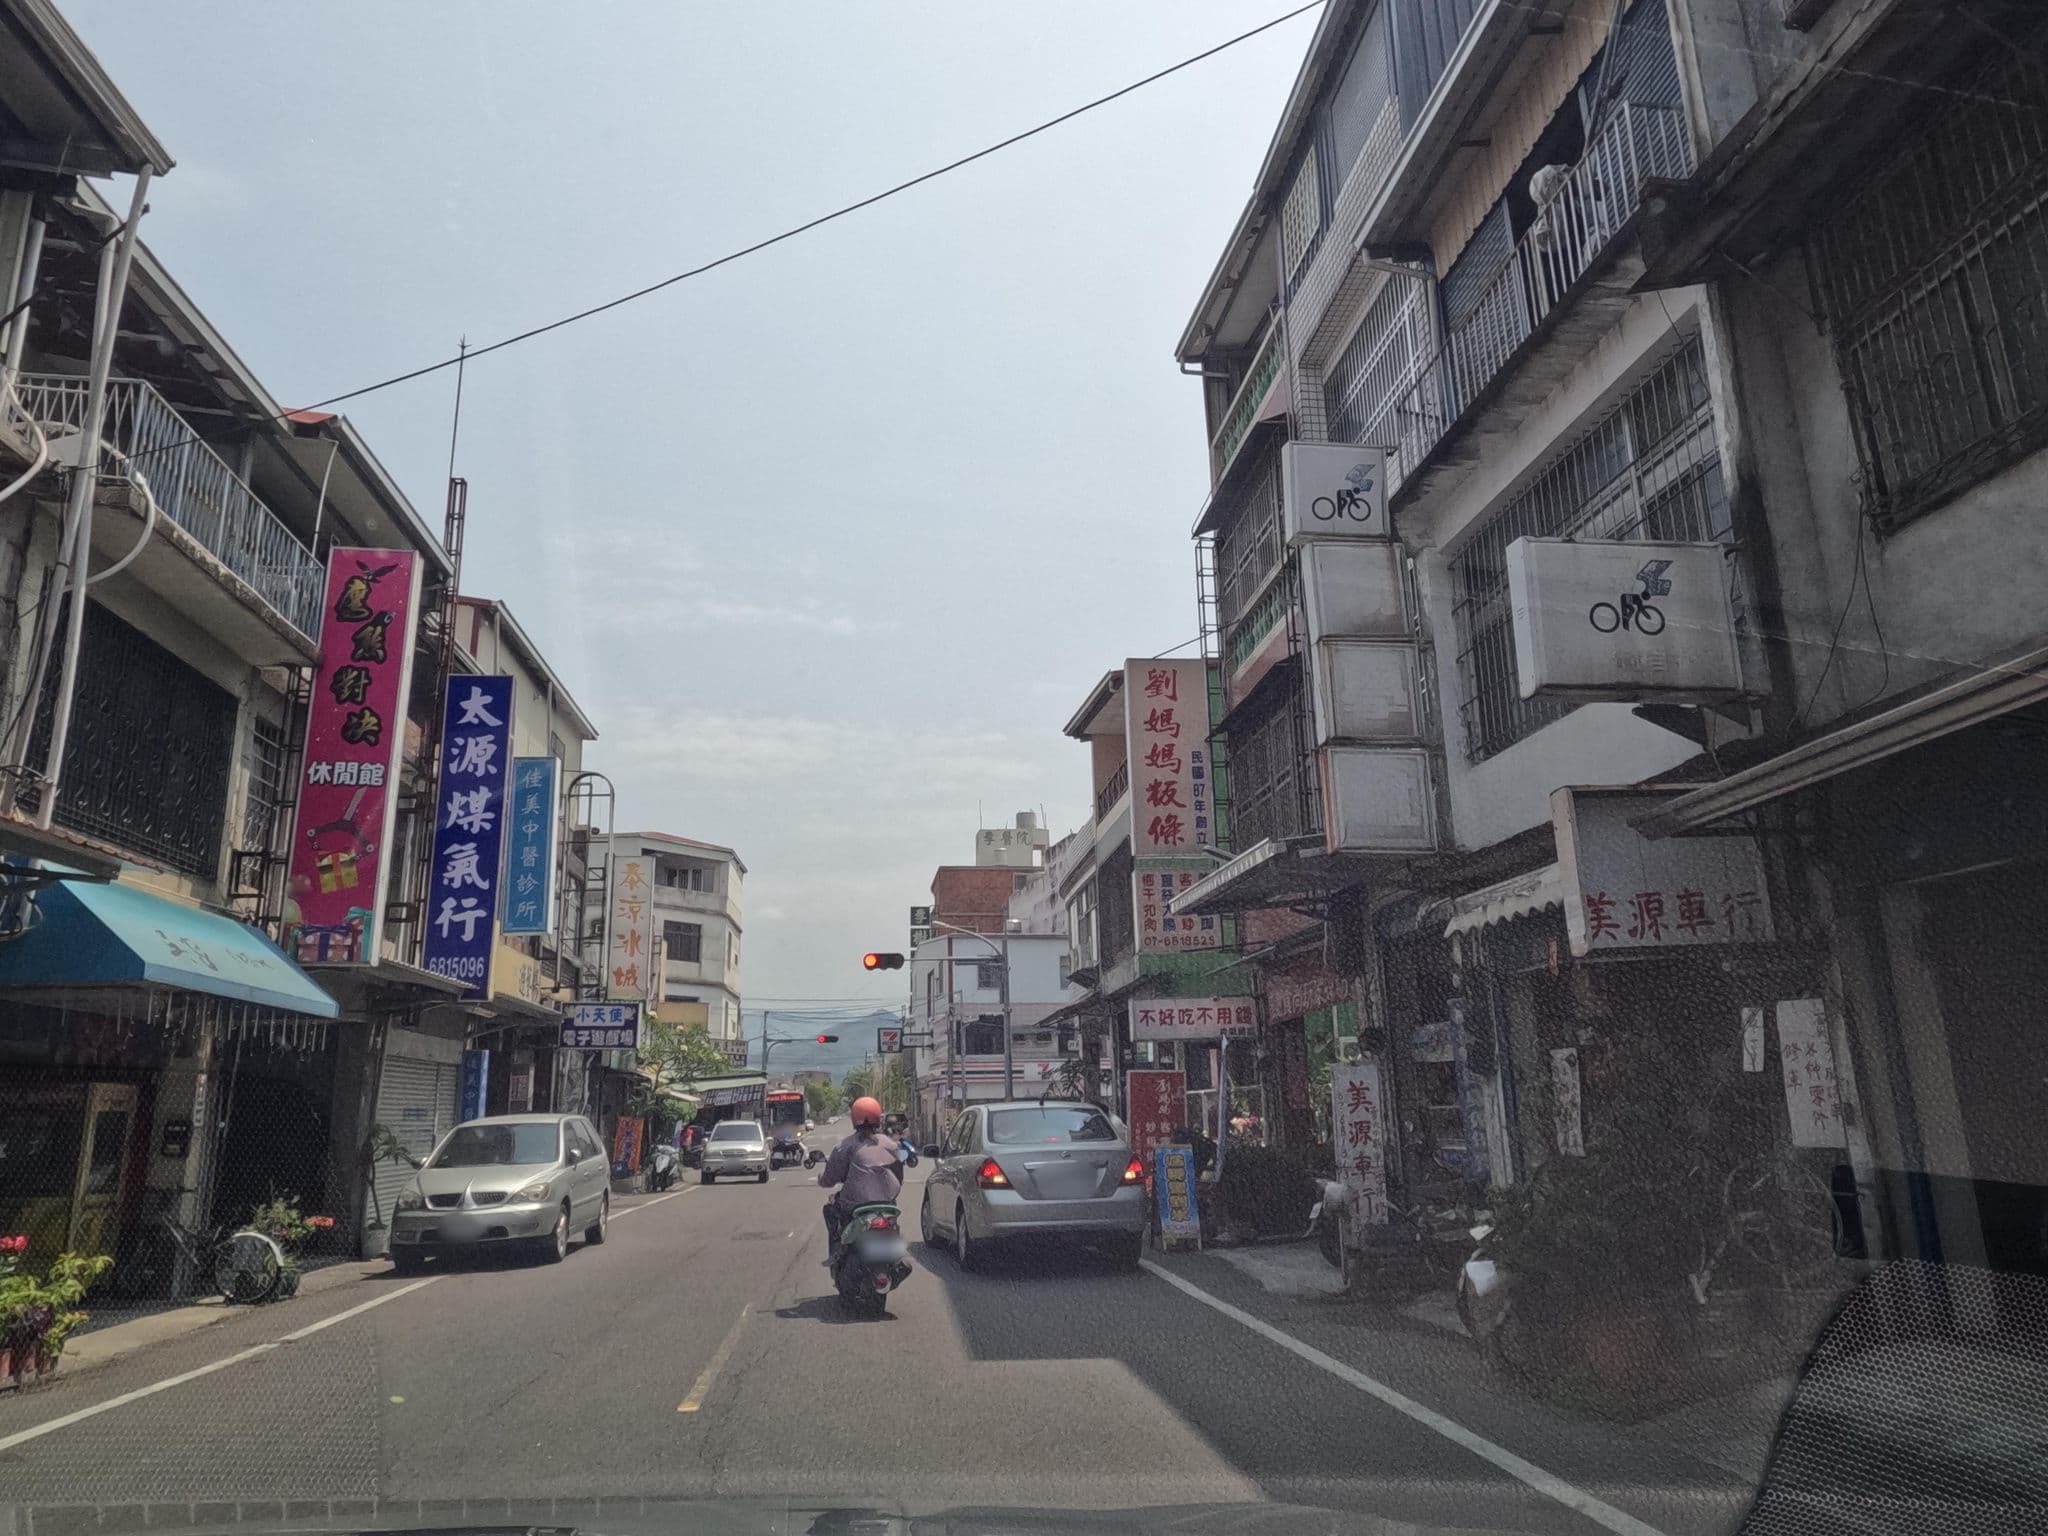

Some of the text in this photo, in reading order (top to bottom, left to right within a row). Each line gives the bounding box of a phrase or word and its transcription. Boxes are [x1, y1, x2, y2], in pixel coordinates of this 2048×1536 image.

[434, 686, 503, 942] 太源煤氣行
[515, 768, 545, 922] 佳美中醫診所
[1586, 887, 1761, 941] 美源車行
[429, 956, 485, 978] 6815096
[576, 1007, 622, 1024] 小天使
[1346, 1080, 1376, 1216] 美源車行
